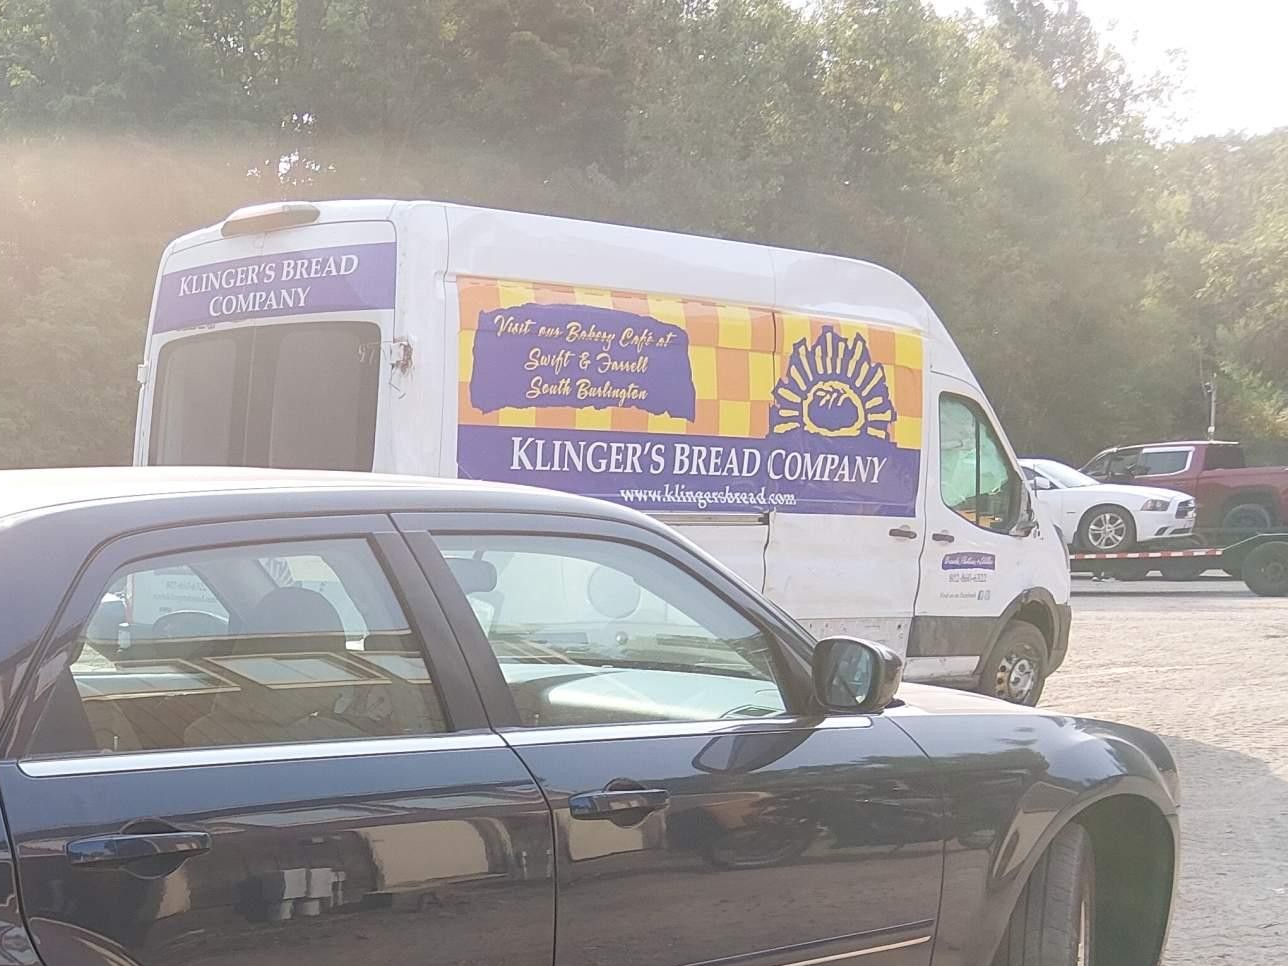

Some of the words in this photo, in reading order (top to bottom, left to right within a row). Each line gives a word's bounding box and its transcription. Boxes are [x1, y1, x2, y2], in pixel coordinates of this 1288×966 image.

[178, 262, 276, 297] KLINGER'S
[281, 254, 359, 282] BREAD
[209, 286, 311, 317] COMPANY
[493, 315, 536, 337] Visit
[538, 324, 563, 338] our
[566, 322, 615, 351] Bakery
[619, 327, 656, 352] Café
[655, 332, 678, 348] at
[524, 348, 576, 375] Swift
[579, 352, 591, 370] &
[596, 353, 648, 374] Farrell
[526, 376, 572, 399] South
[576, 379, 648, 406] Burlington
[510, 437, 665, 475] KLINGER'S
[672, 443, 761, 478] BREAD
[767, 449, 888, 483] COMPANY
[620, 484, 796, 510] www.klingersbread.com
